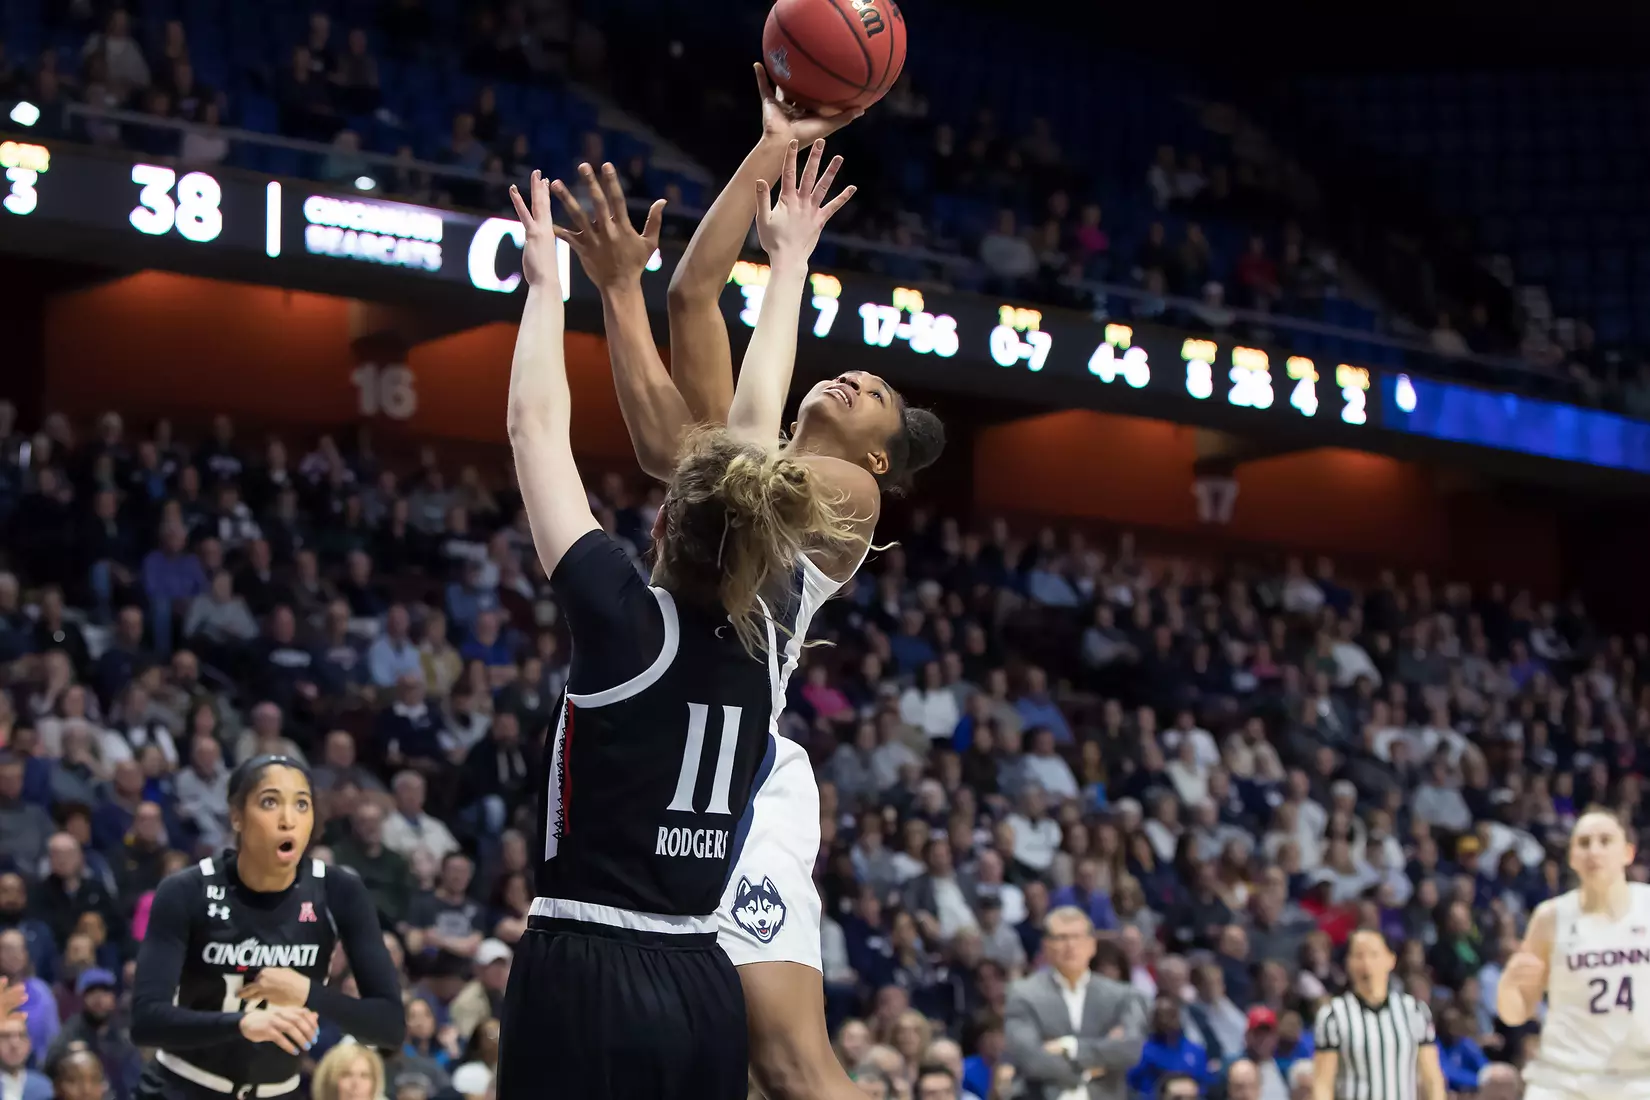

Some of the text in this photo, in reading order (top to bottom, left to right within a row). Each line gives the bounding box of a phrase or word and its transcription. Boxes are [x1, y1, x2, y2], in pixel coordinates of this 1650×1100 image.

[4, 166, 38, 215] 3
[129, 164, 223, 242] 38
[812, 295, 839, 338] 7
[351, 363, 417, 418] 16
[666, 702, 743, 814] 11
[202, 938, 320, 967] CINCINNATI
[1567, 949, 1650, 972] UCONN
[1588, 976, 1634, 1014] 24
